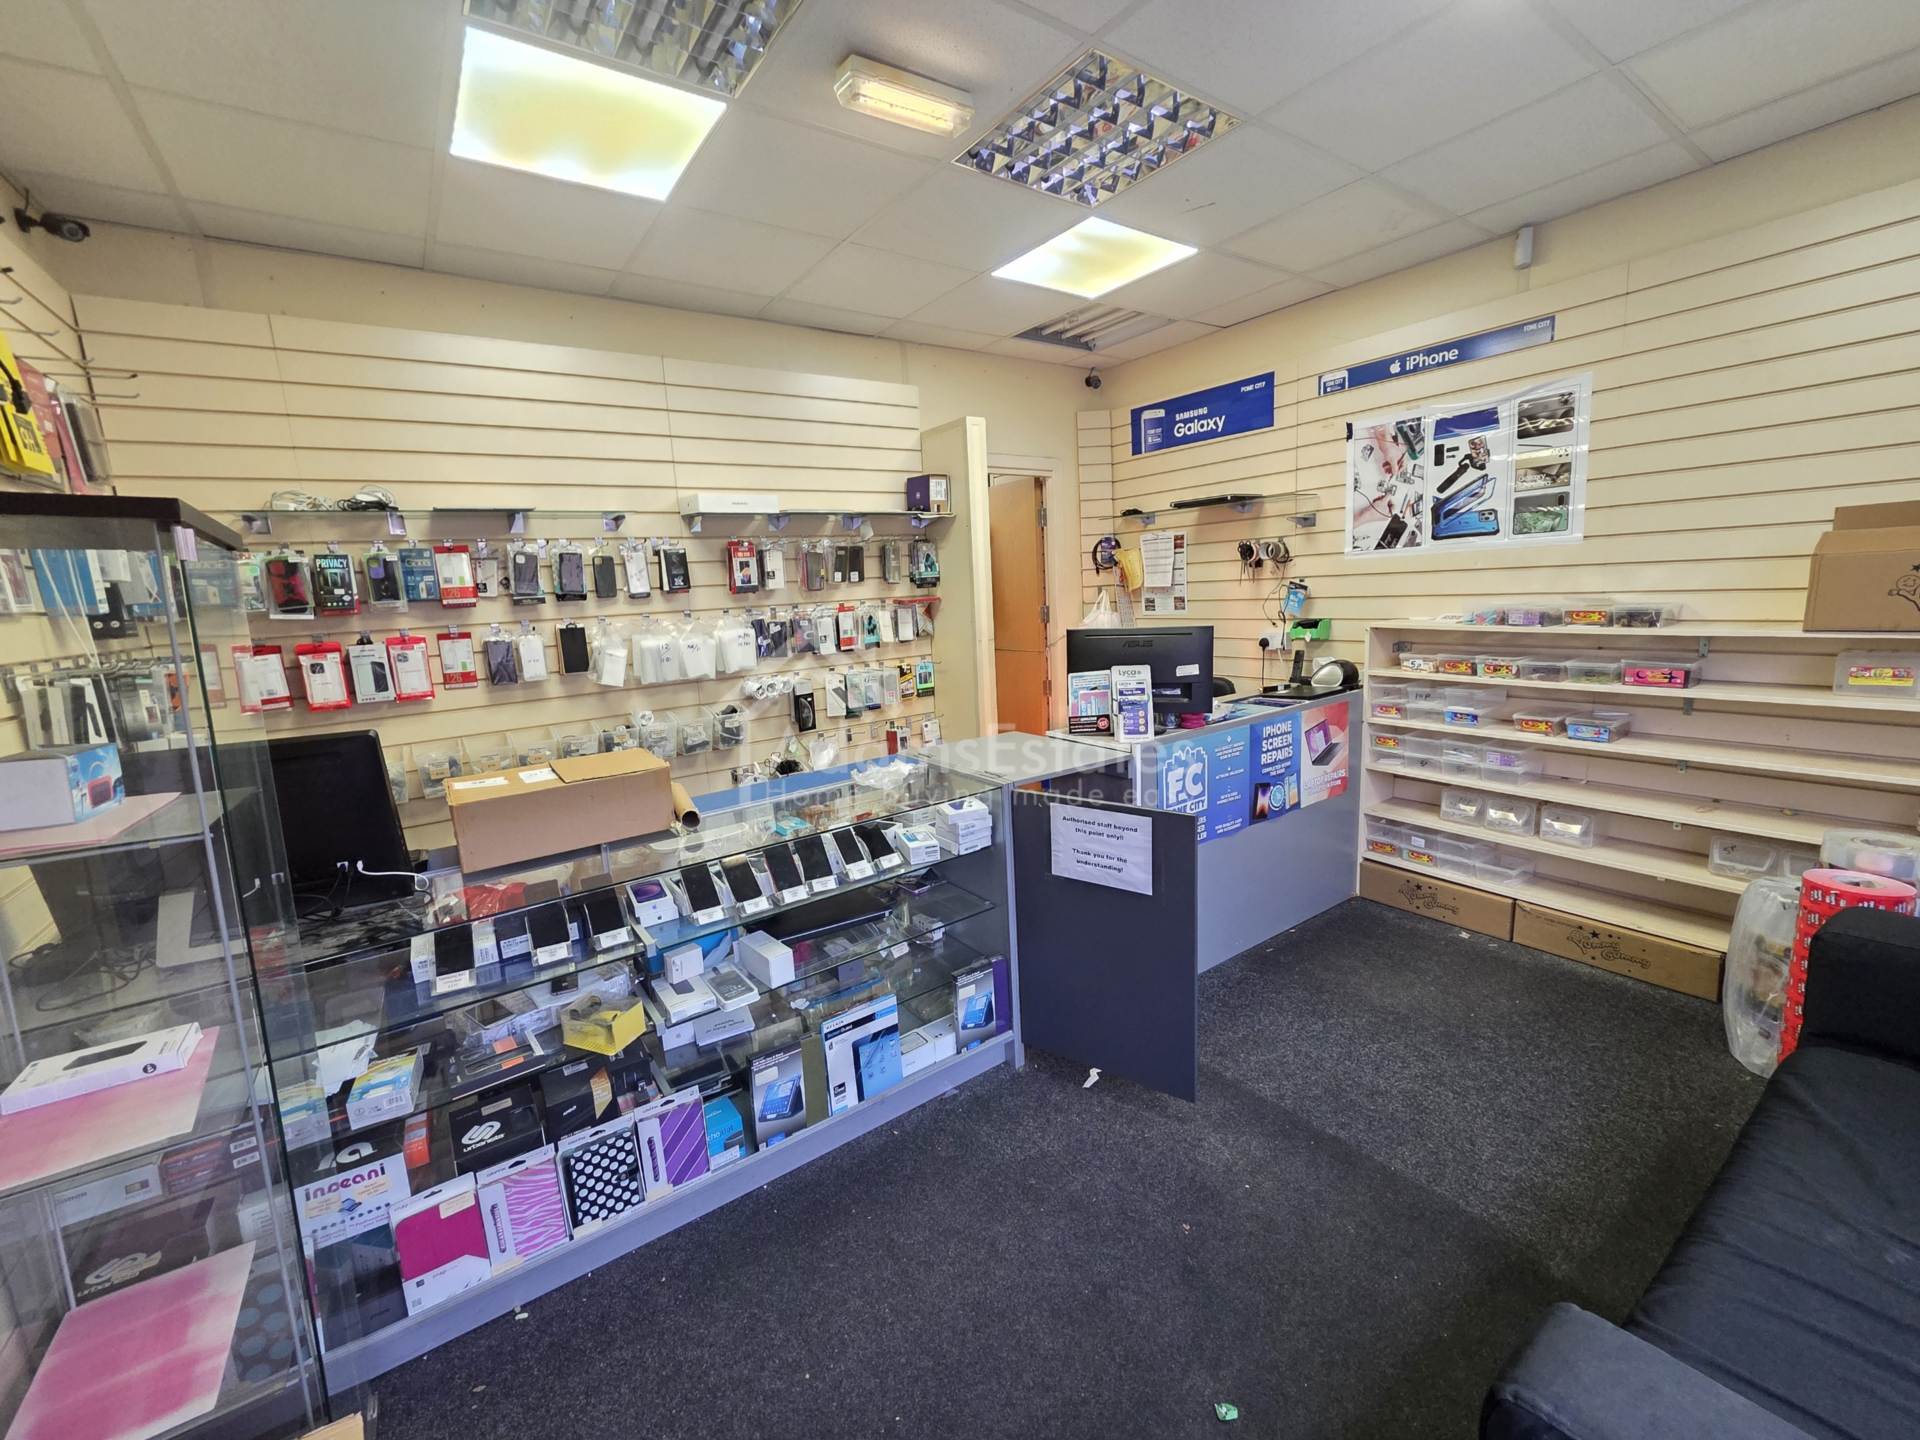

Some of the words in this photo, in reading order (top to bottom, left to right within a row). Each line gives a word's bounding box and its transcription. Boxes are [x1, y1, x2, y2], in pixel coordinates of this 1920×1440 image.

[1405, 348, 1459, 371] iPhone
[1175, 406, 1208, 421] SAMSUNG
[1174, 415, 1226, 438] Galaxy
[315, 558, 348, 571] PRIVACY
[1122, 640, 1153, 648] ASUS
[1262, 720, 1293, 738] IPHONE
[1261, 733, 1293, 752] SCREEN
[1261, 745, 1294, 765] REPAIRS
[1188, 799, 1206, 812] CITY
[1062, 815, 1096, 826] Authorised
[1113, 824, 1138, 833] beyond
[1088, 830, 1104, 838] point
[1071, 847, 1091, 856] Thank
[1093, 852, 1105, 860] you
[1116, 856, 1128, 864] the
